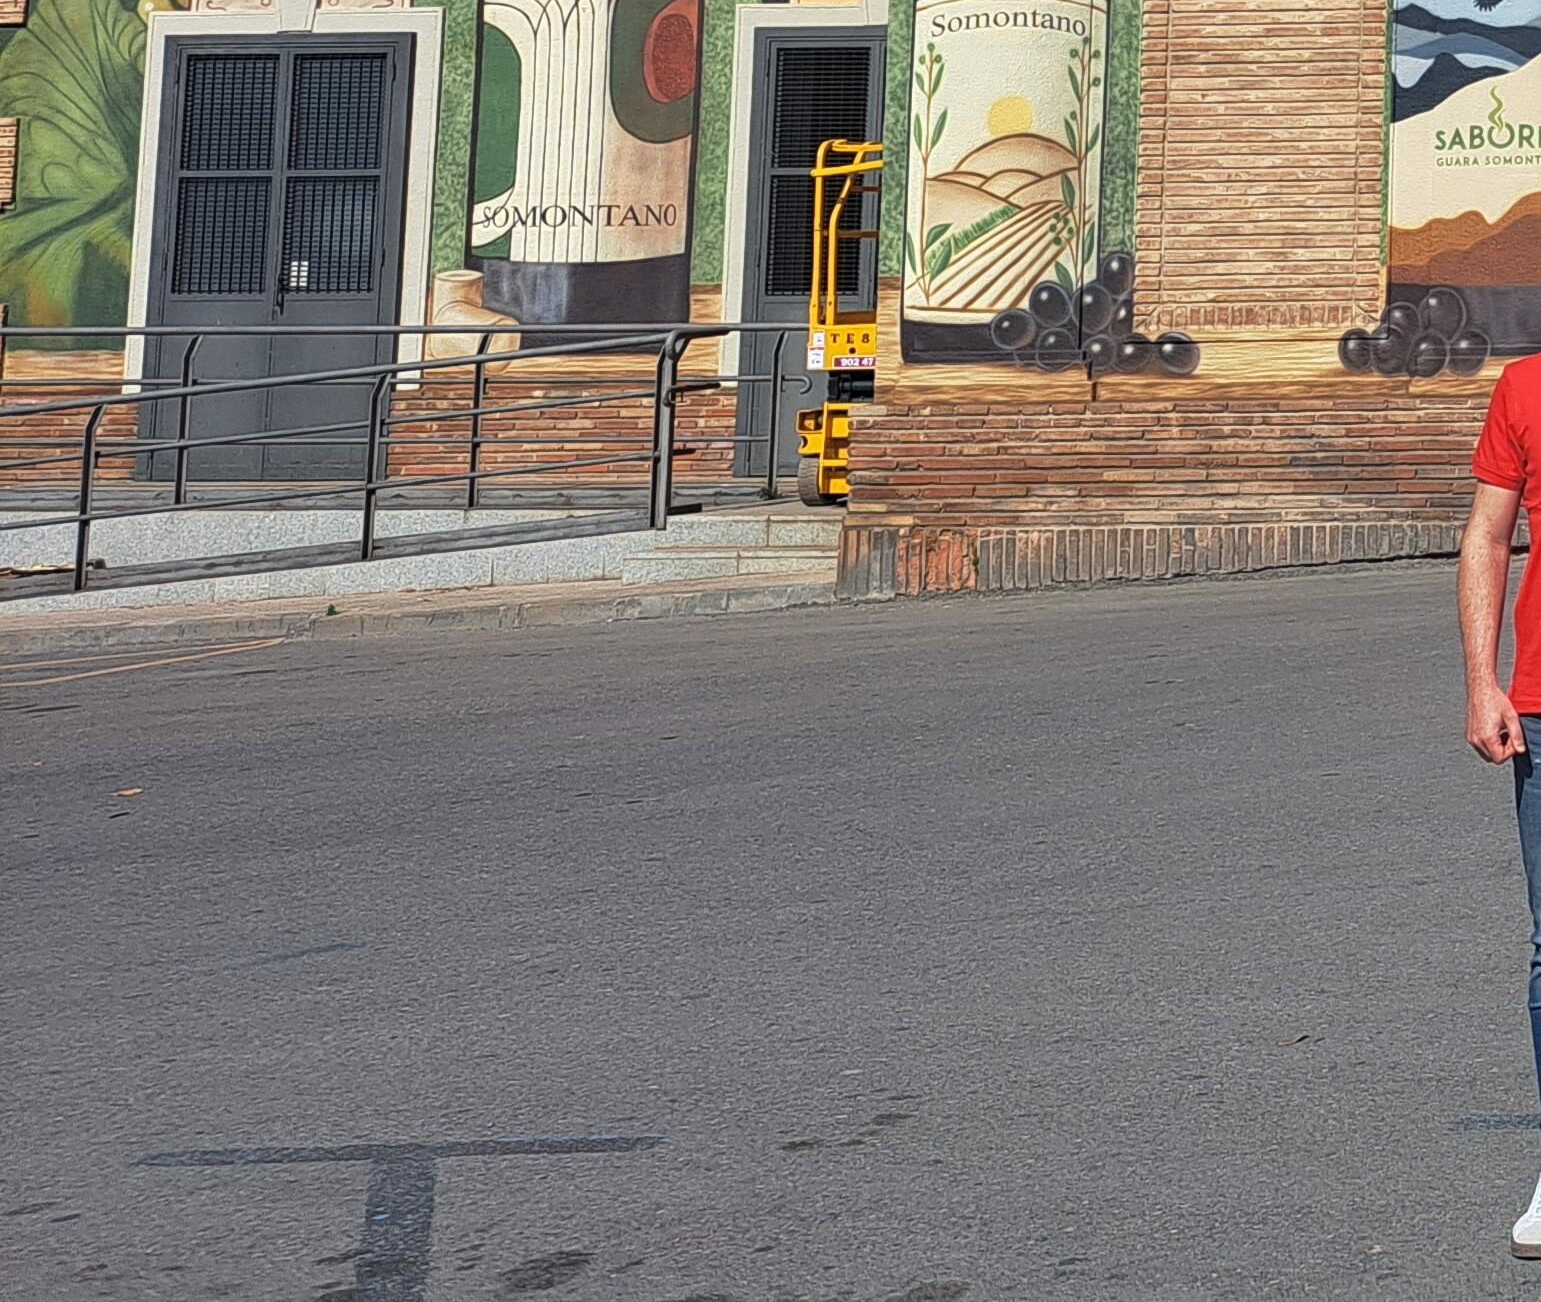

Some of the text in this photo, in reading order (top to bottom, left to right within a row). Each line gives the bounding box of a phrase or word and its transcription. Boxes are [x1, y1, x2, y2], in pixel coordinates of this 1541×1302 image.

[931, 8, 1086, 38] Somontano
[1436, 155, 1480, 167] GUARA
[482, 203, 677, 229] SOMONTANO
